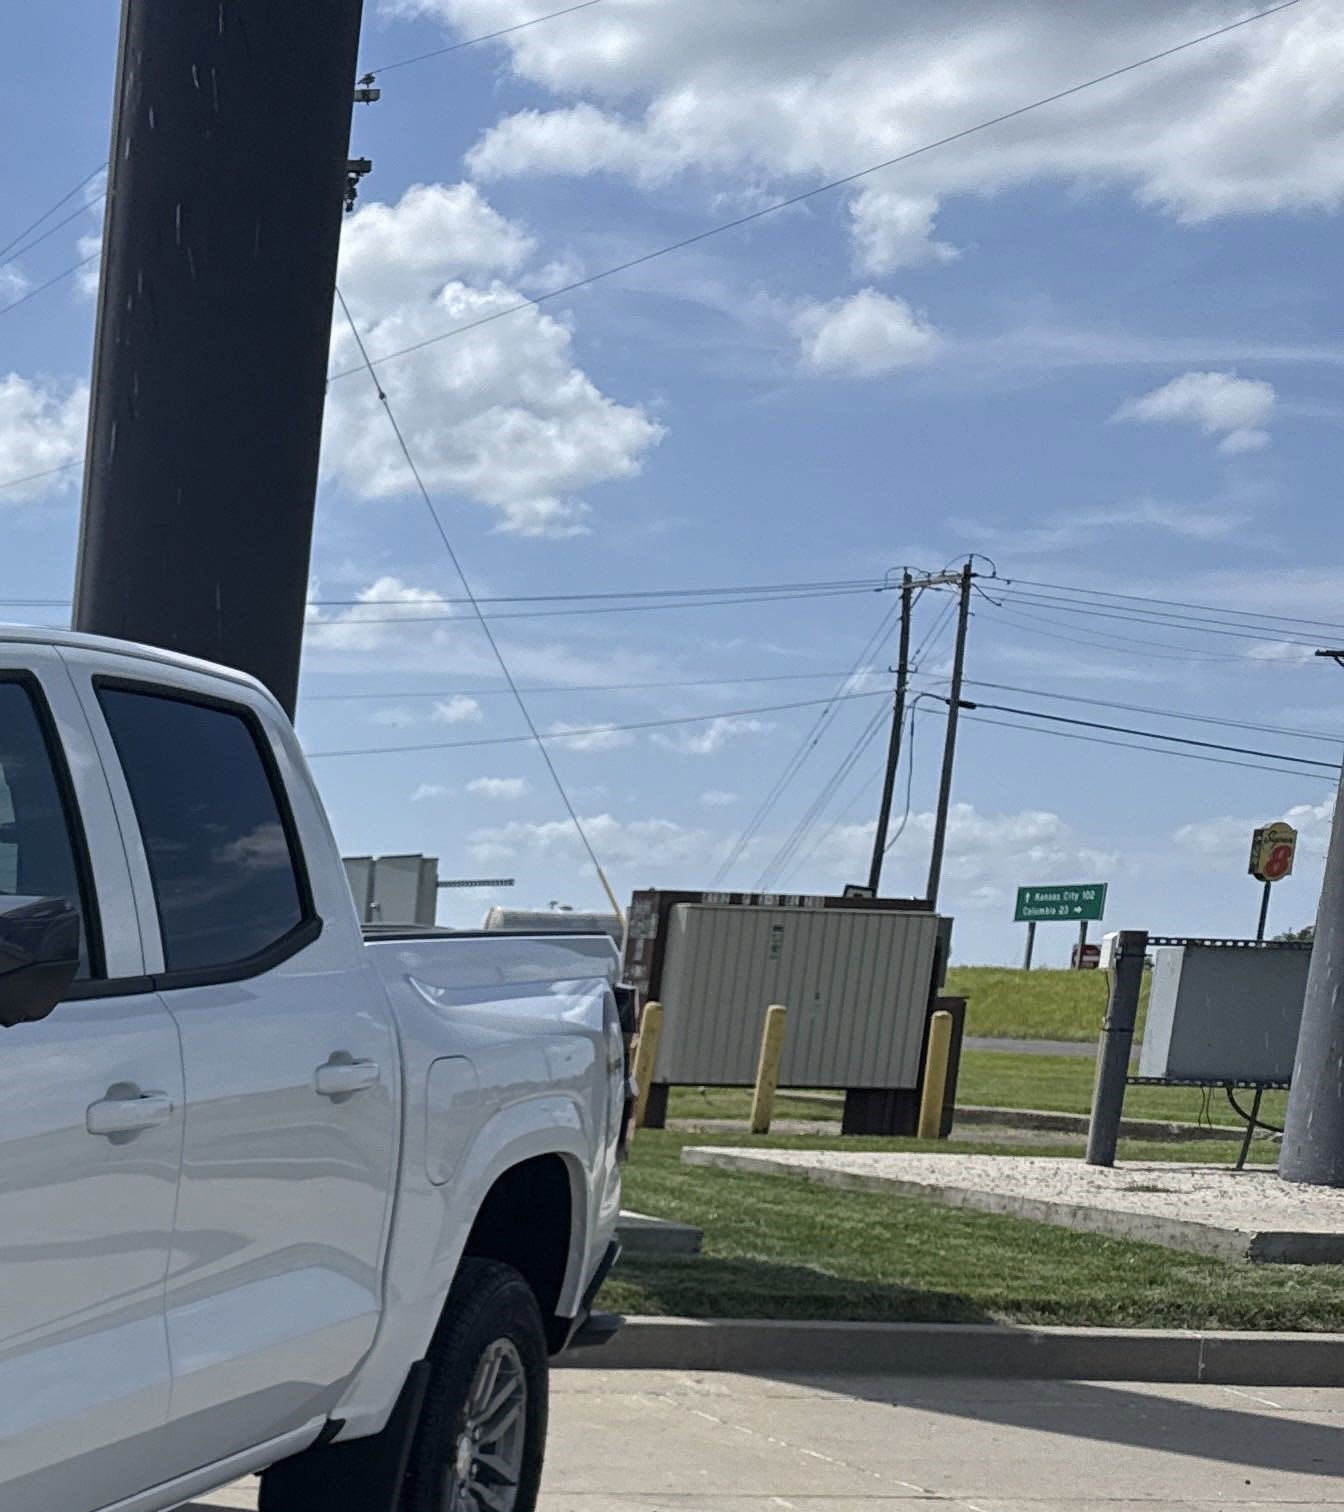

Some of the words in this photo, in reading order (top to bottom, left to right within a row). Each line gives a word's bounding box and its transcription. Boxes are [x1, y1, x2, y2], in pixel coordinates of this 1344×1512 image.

[1263, 845, 1293, 877] 8
[1034, 893, 1061, 902] Kansas
[1063, 891, 1080, 902] City
[1082, 890, 1096, 900] 102
